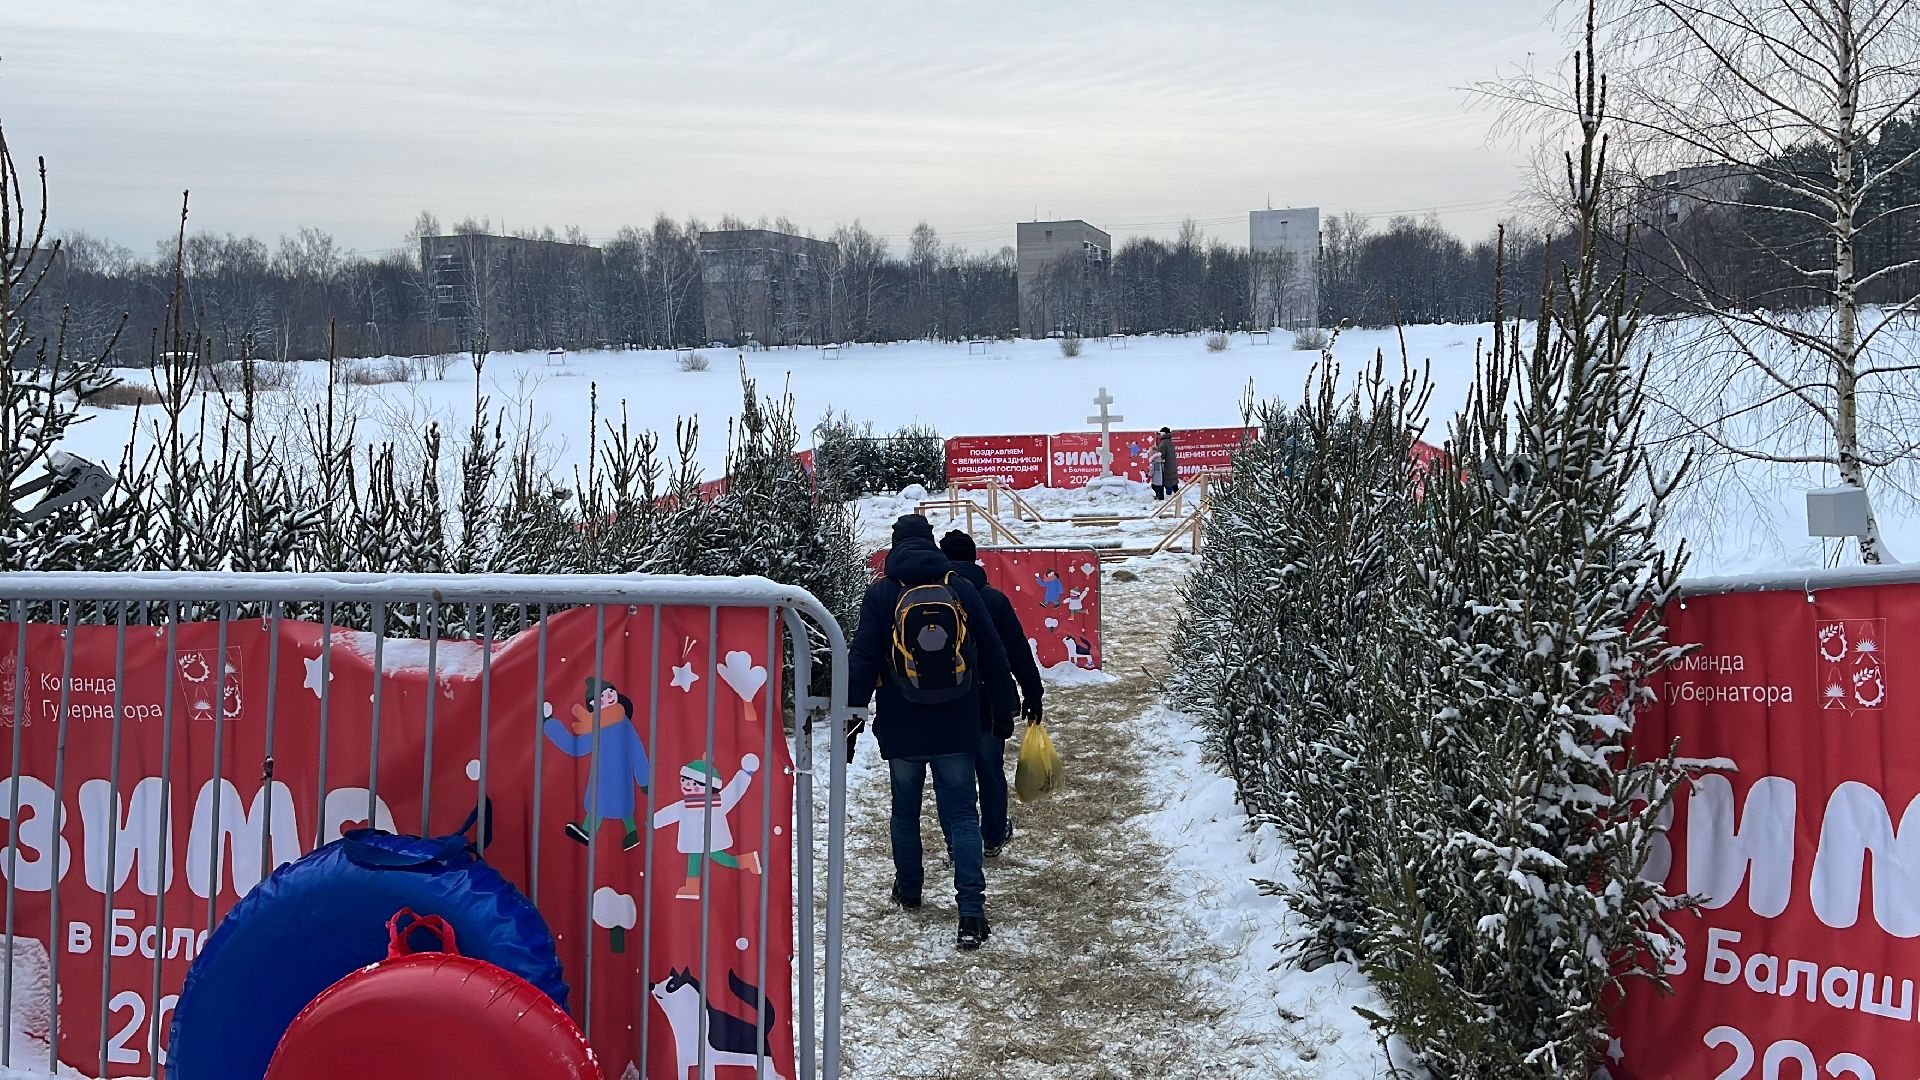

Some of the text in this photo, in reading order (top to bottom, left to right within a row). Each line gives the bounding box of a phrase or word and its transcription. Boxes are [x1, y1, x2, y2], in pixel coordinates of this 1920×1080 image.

[970, 448, 1024, 457] ПОЗДРАВЛЯЕМ
[1053, 451, 1113, 466] ЗИМ
[993, 456, 1043, 465] ПРАЗДНИКОМ
[957, 466, 996, 474] КРЕЩЕНИЯ
[1070, 475, 1095, 484] 202
[1663, 681, 1793, 707] Губернатора
[42, 699, 163, 723] Гуернаора
[68, 921, 92, 954] в
[1703, 926, 1920, 1022] Балаш
